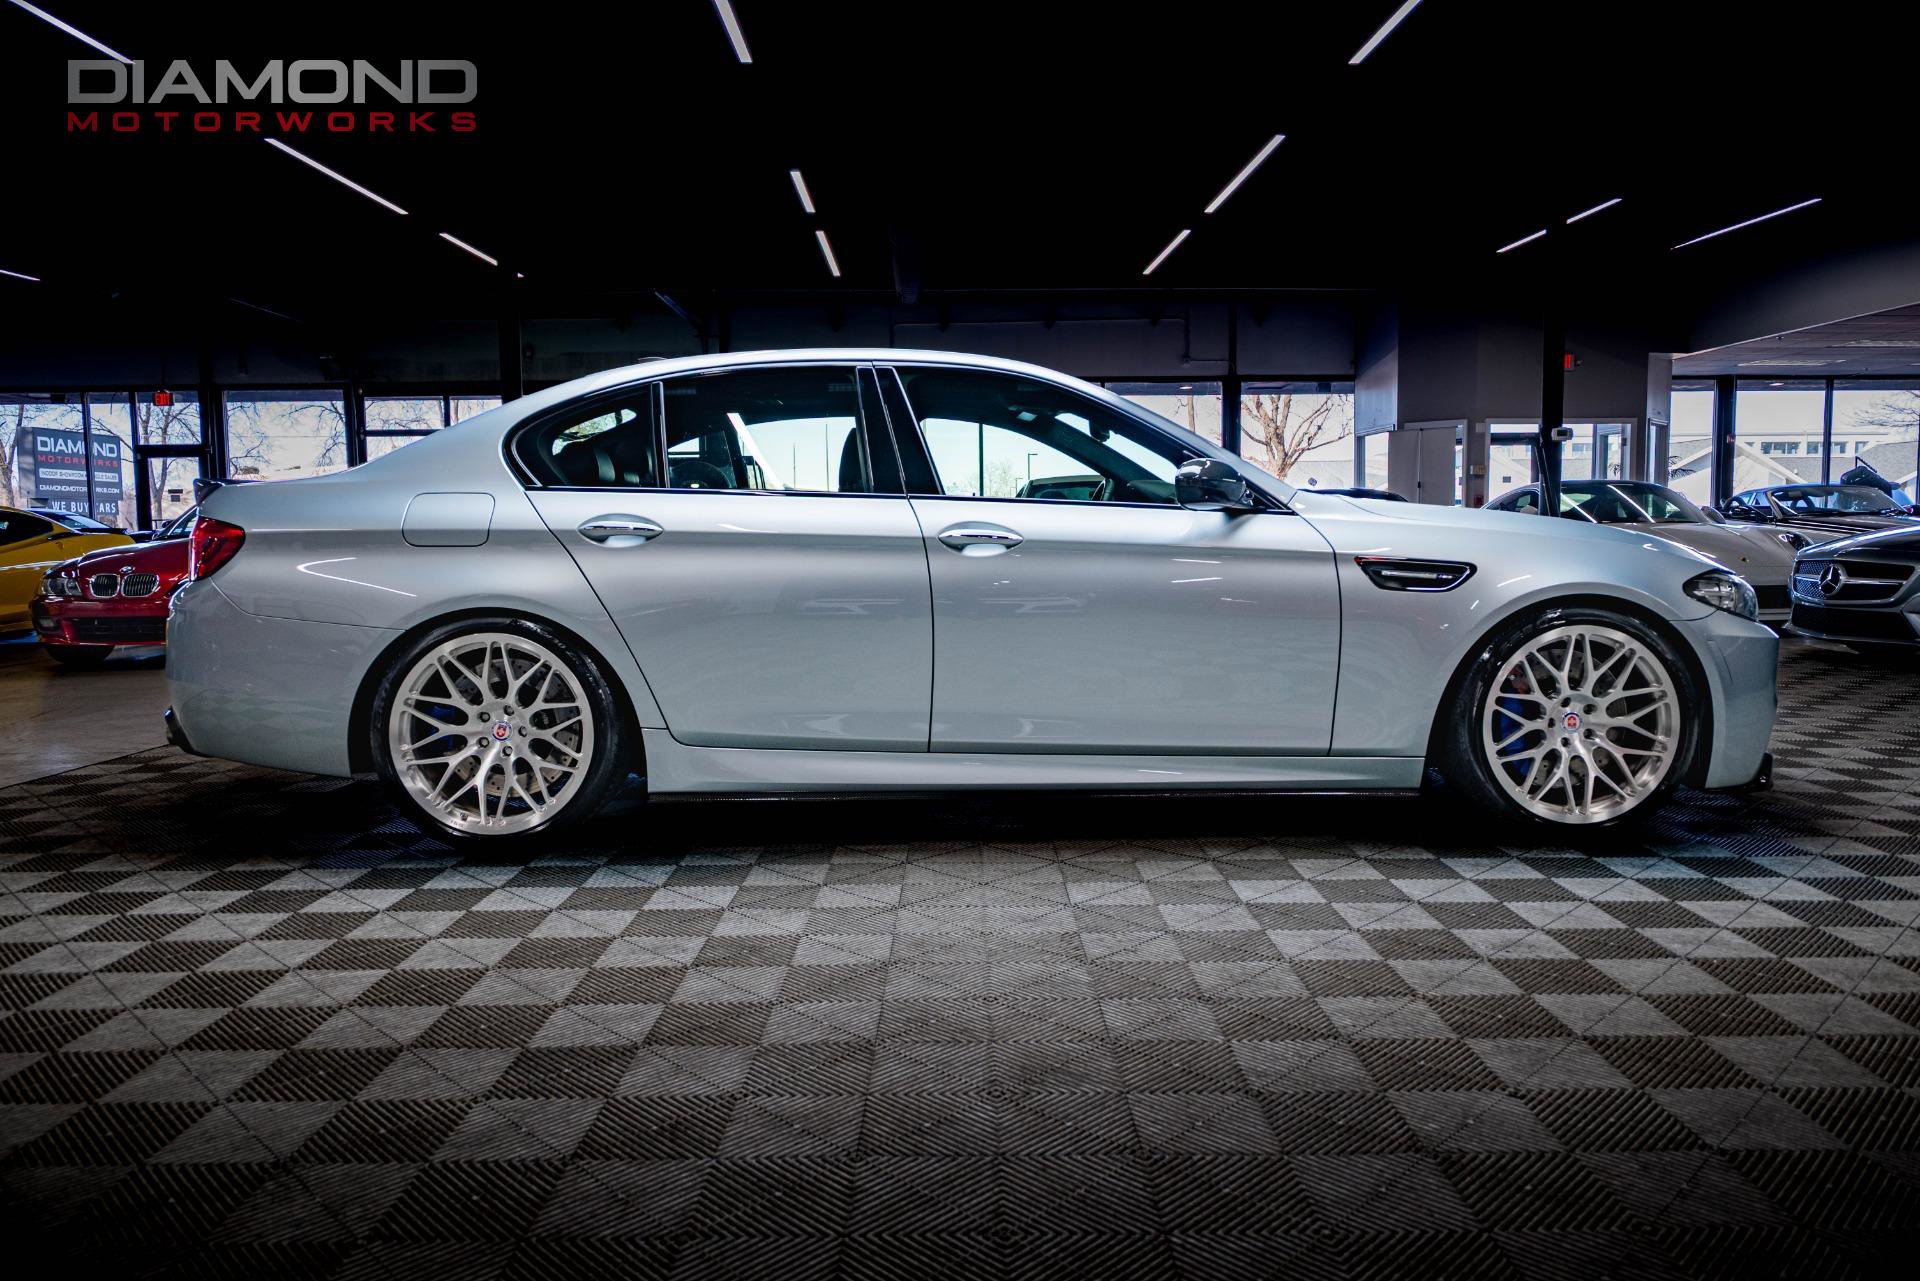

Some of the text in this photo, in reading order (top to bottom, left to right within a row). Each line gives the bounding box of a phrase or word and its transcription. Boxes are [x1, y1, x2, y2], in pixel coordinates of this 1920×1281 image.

[37, 436, 117, 457] DIAMND
[38, 454, 118, 467] MOTORWRKS
[39, 484, 120, 494] DIAMONDMOTORRKS.COM
[52, 501, 116, 513] WE BUY ARS
